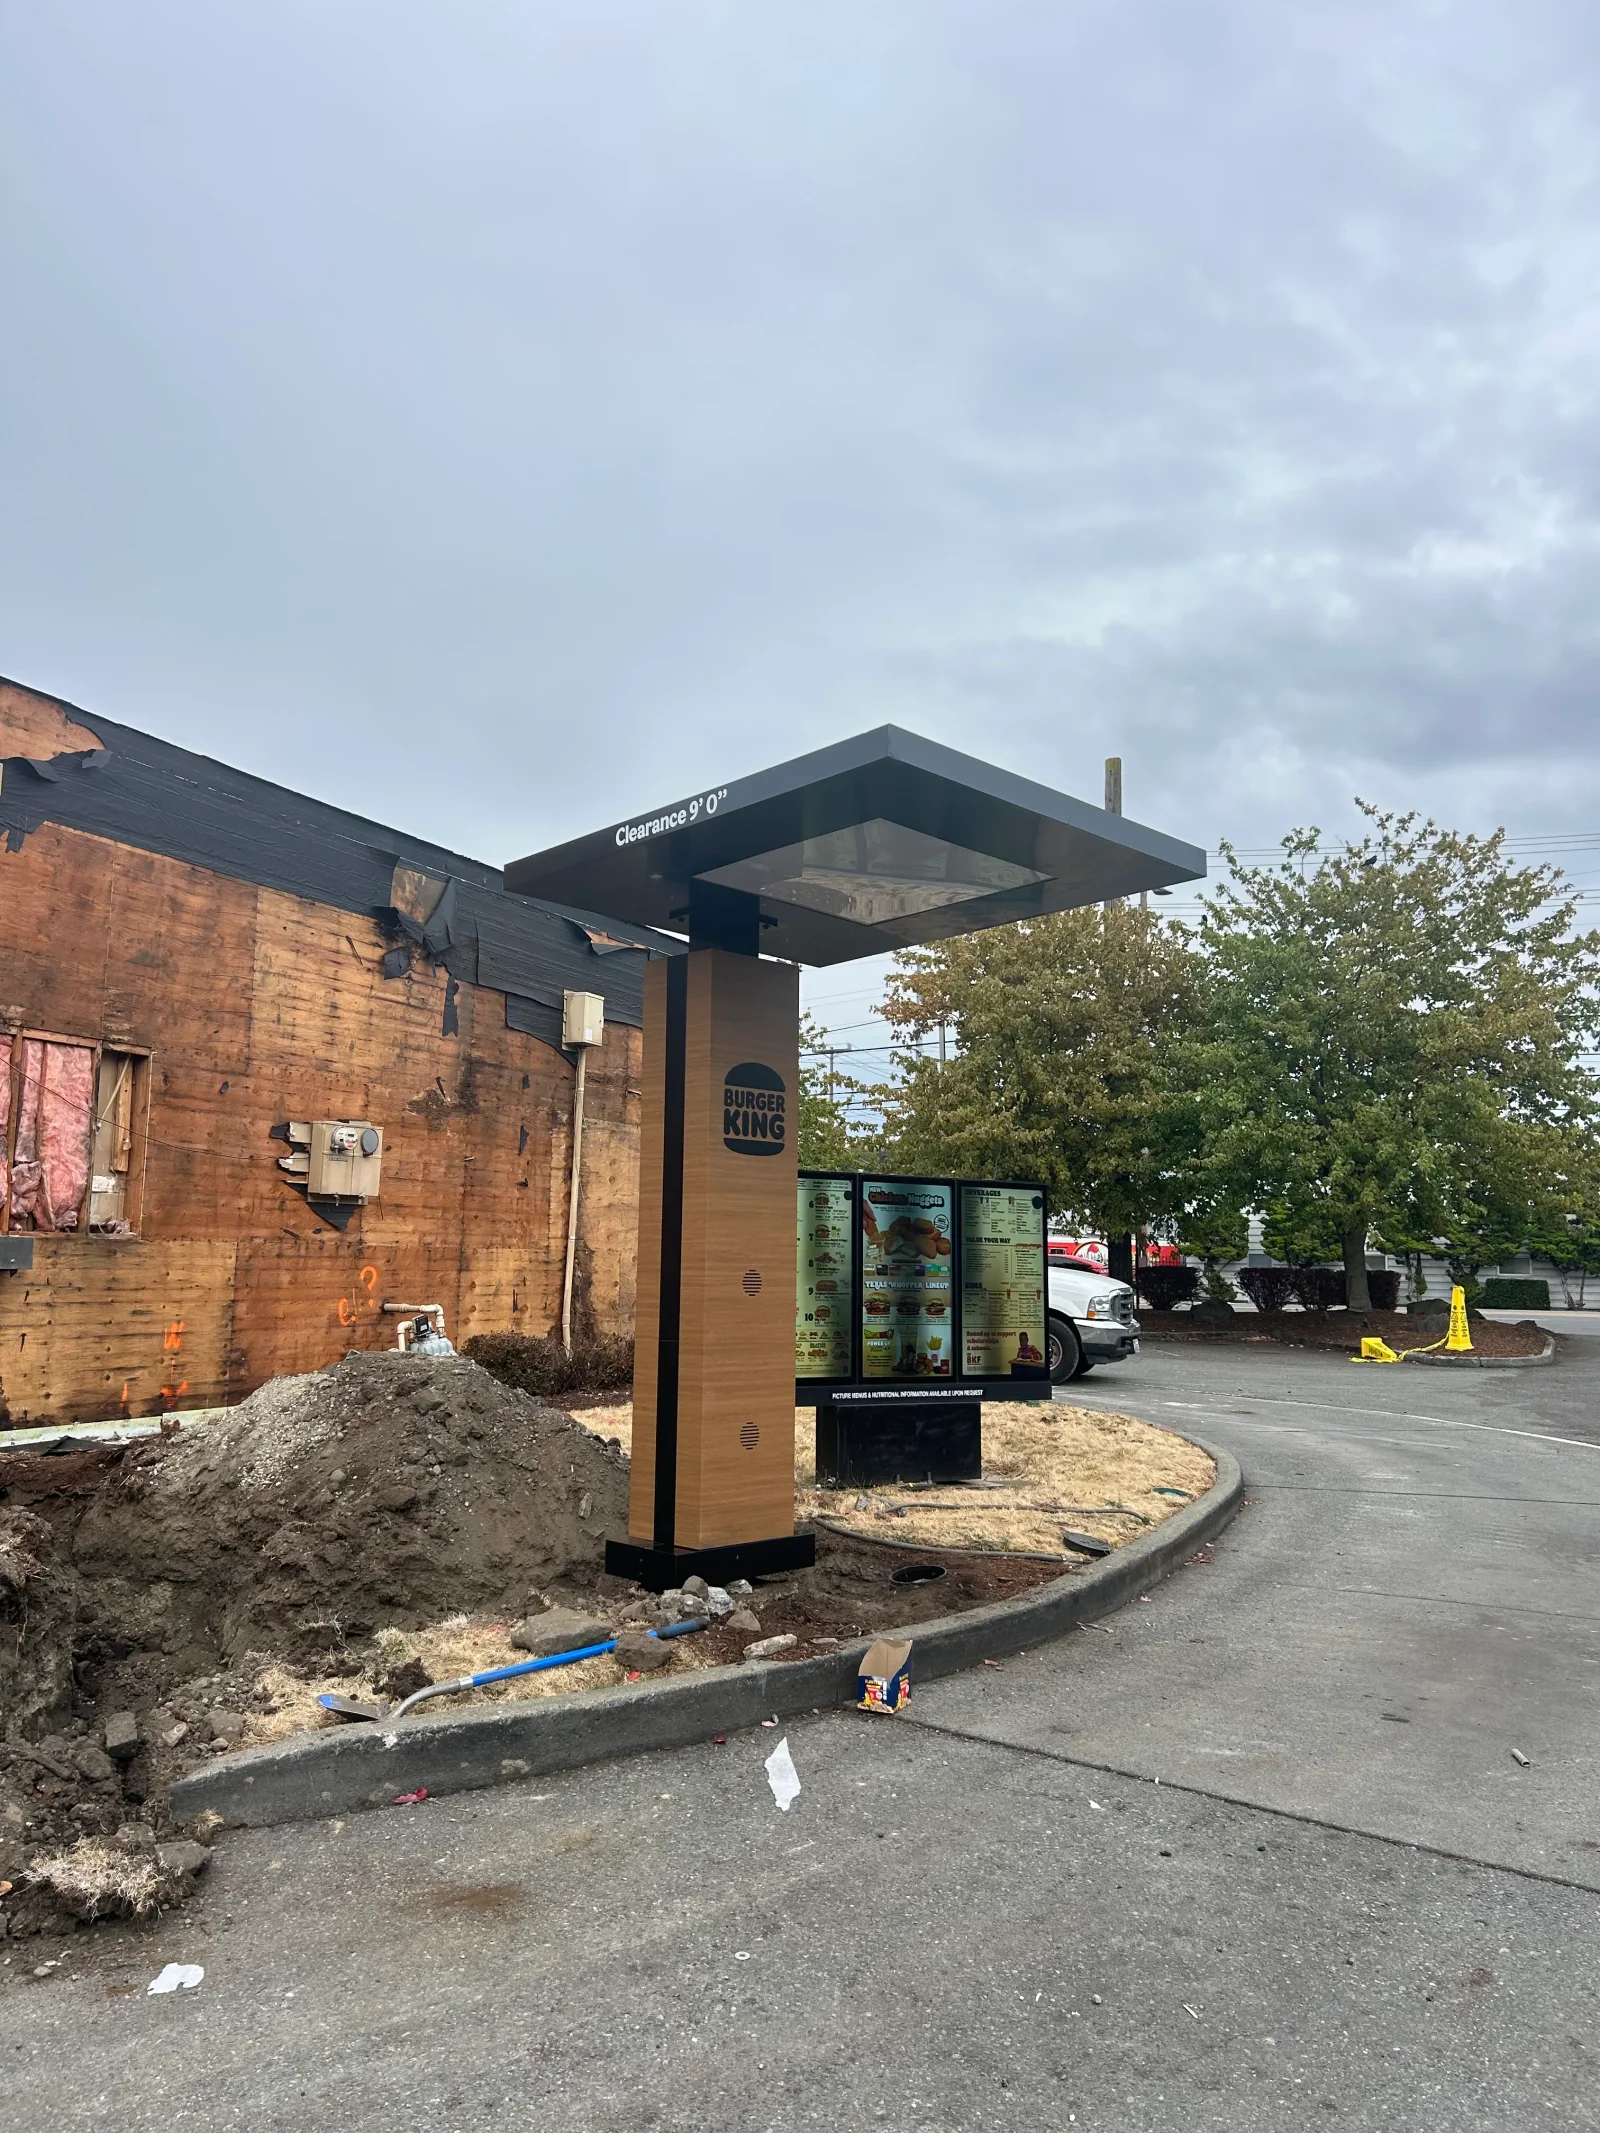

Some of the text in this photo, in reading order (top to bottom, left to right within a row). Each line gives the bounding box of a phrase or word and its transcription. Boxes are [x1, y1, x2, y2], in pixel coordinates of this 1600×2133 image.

[615, 810, 687, 846] Clearance
[724, 1088, 786, 1113] BURGER
[723, 1108, 785, 1140] KING
[965, 1188, 1001, 1197] BEVERAGES
[808, 1200, 814, 1208] 6
[907, 1193, 943, 1207] Nuggets
[808, 1233, 814, 1241] 7
[808, 1259, 814, 1267] 8
[865, 1281, 888, 1290] TEXAS
[889, 1281, 923, 1289] WHOPPER
[808, 1287, 814, 1295] 9
[804, 1312, 814, 1321] 10
[966, 1356, 982, 1364] BKF
[832, 1392, 851, 1400] PICTURE
[851, 1391, 867, 1399] MENUS
[872, 1390, 900, 1398] NUTRITIONAL
